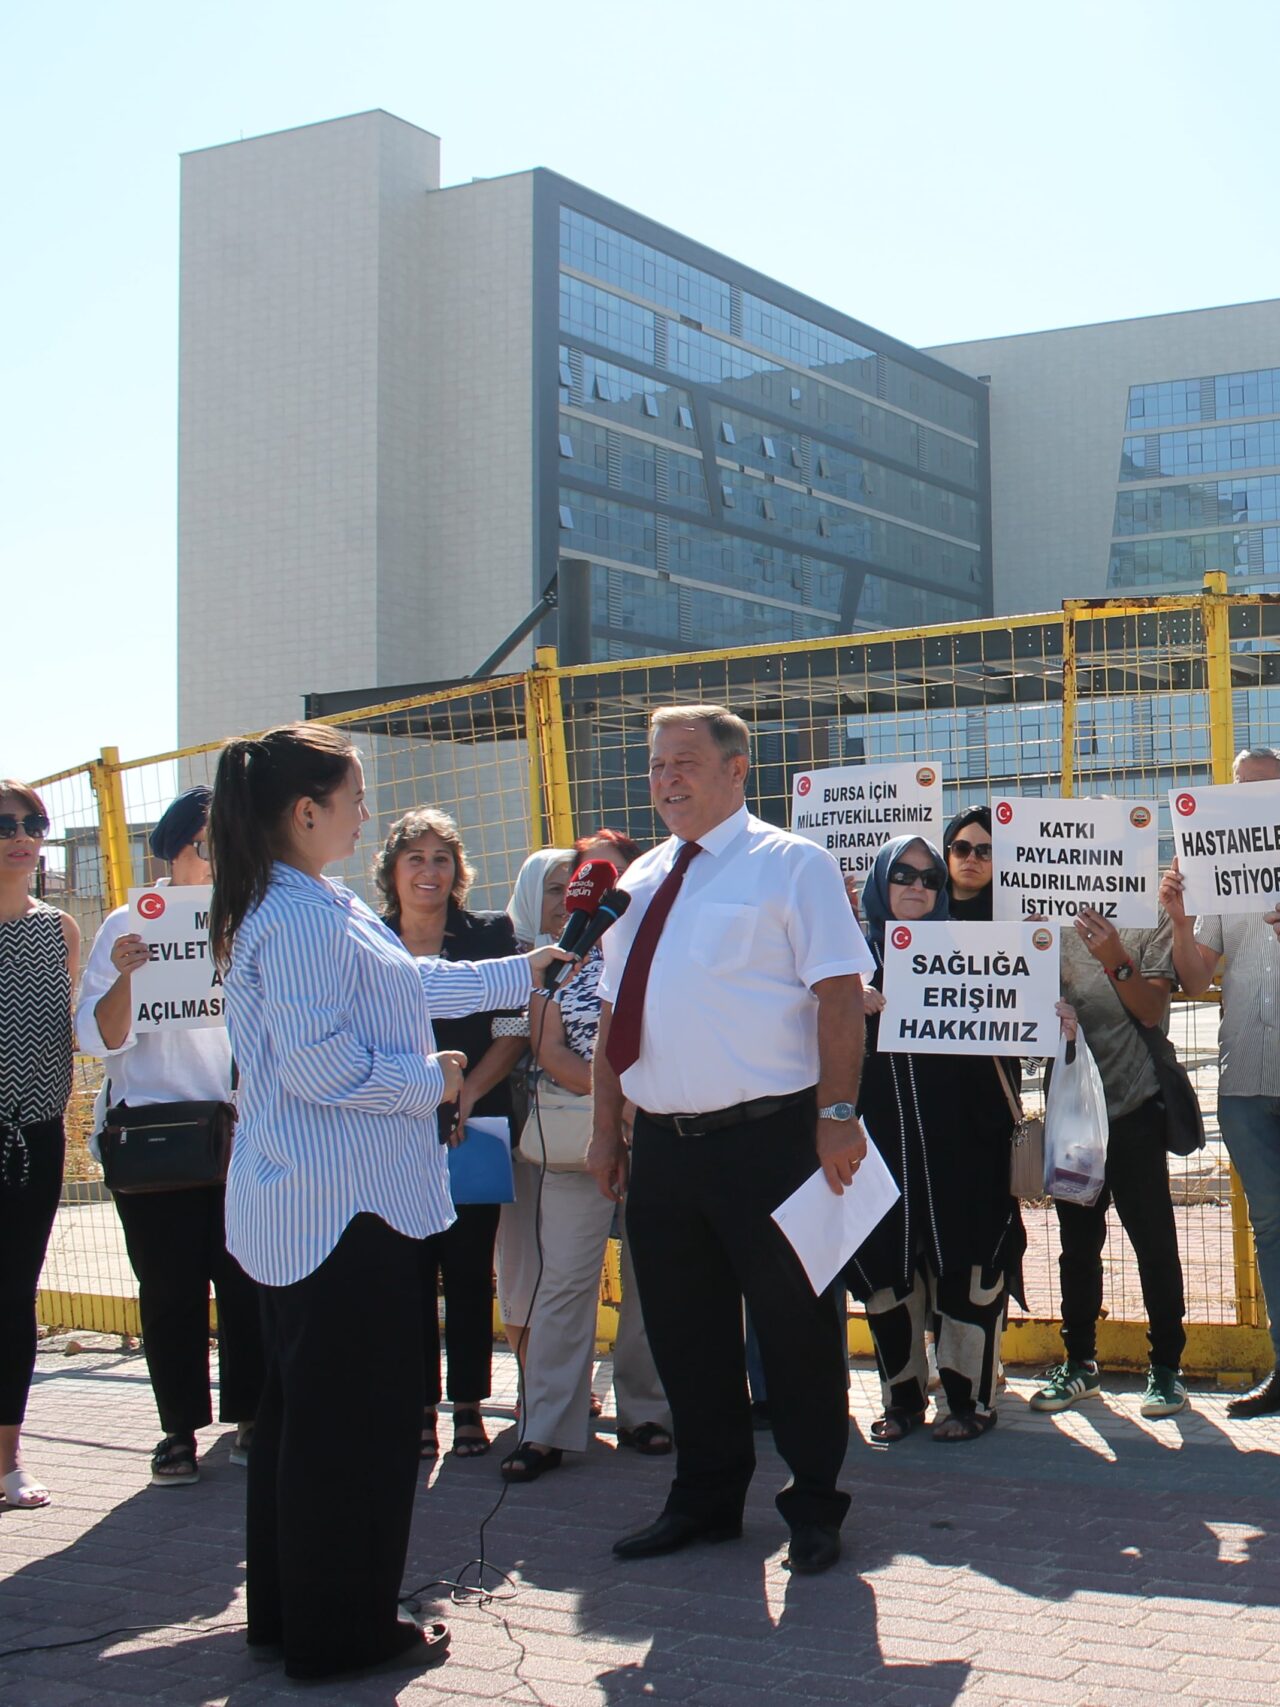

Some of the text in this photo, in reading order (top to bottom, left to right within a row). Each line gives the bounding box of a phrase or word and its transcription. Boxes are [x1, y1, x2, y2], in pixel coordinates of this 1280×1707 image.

[823, 780, 897, 803] BURSA İÇİN
[797, 804, 933, 830] MİLLETVEKİLLERİMİZ
[1039, 821, 1095, 840] KATKI
[838, 853, 874, 872] ELSİ
[1015, 846, 1124, 867] PAYLARININ
[1000, 871, 1146, 893] KALDIRILMASINI
[149, 941, 208, 962] EVLET
[911, 950, 1030, 977] SAĞLIĞA
[923, 983, 1017, 1014] ERİŞİM
[899, 1019, 1038, 1043] HAKKIMIZ
